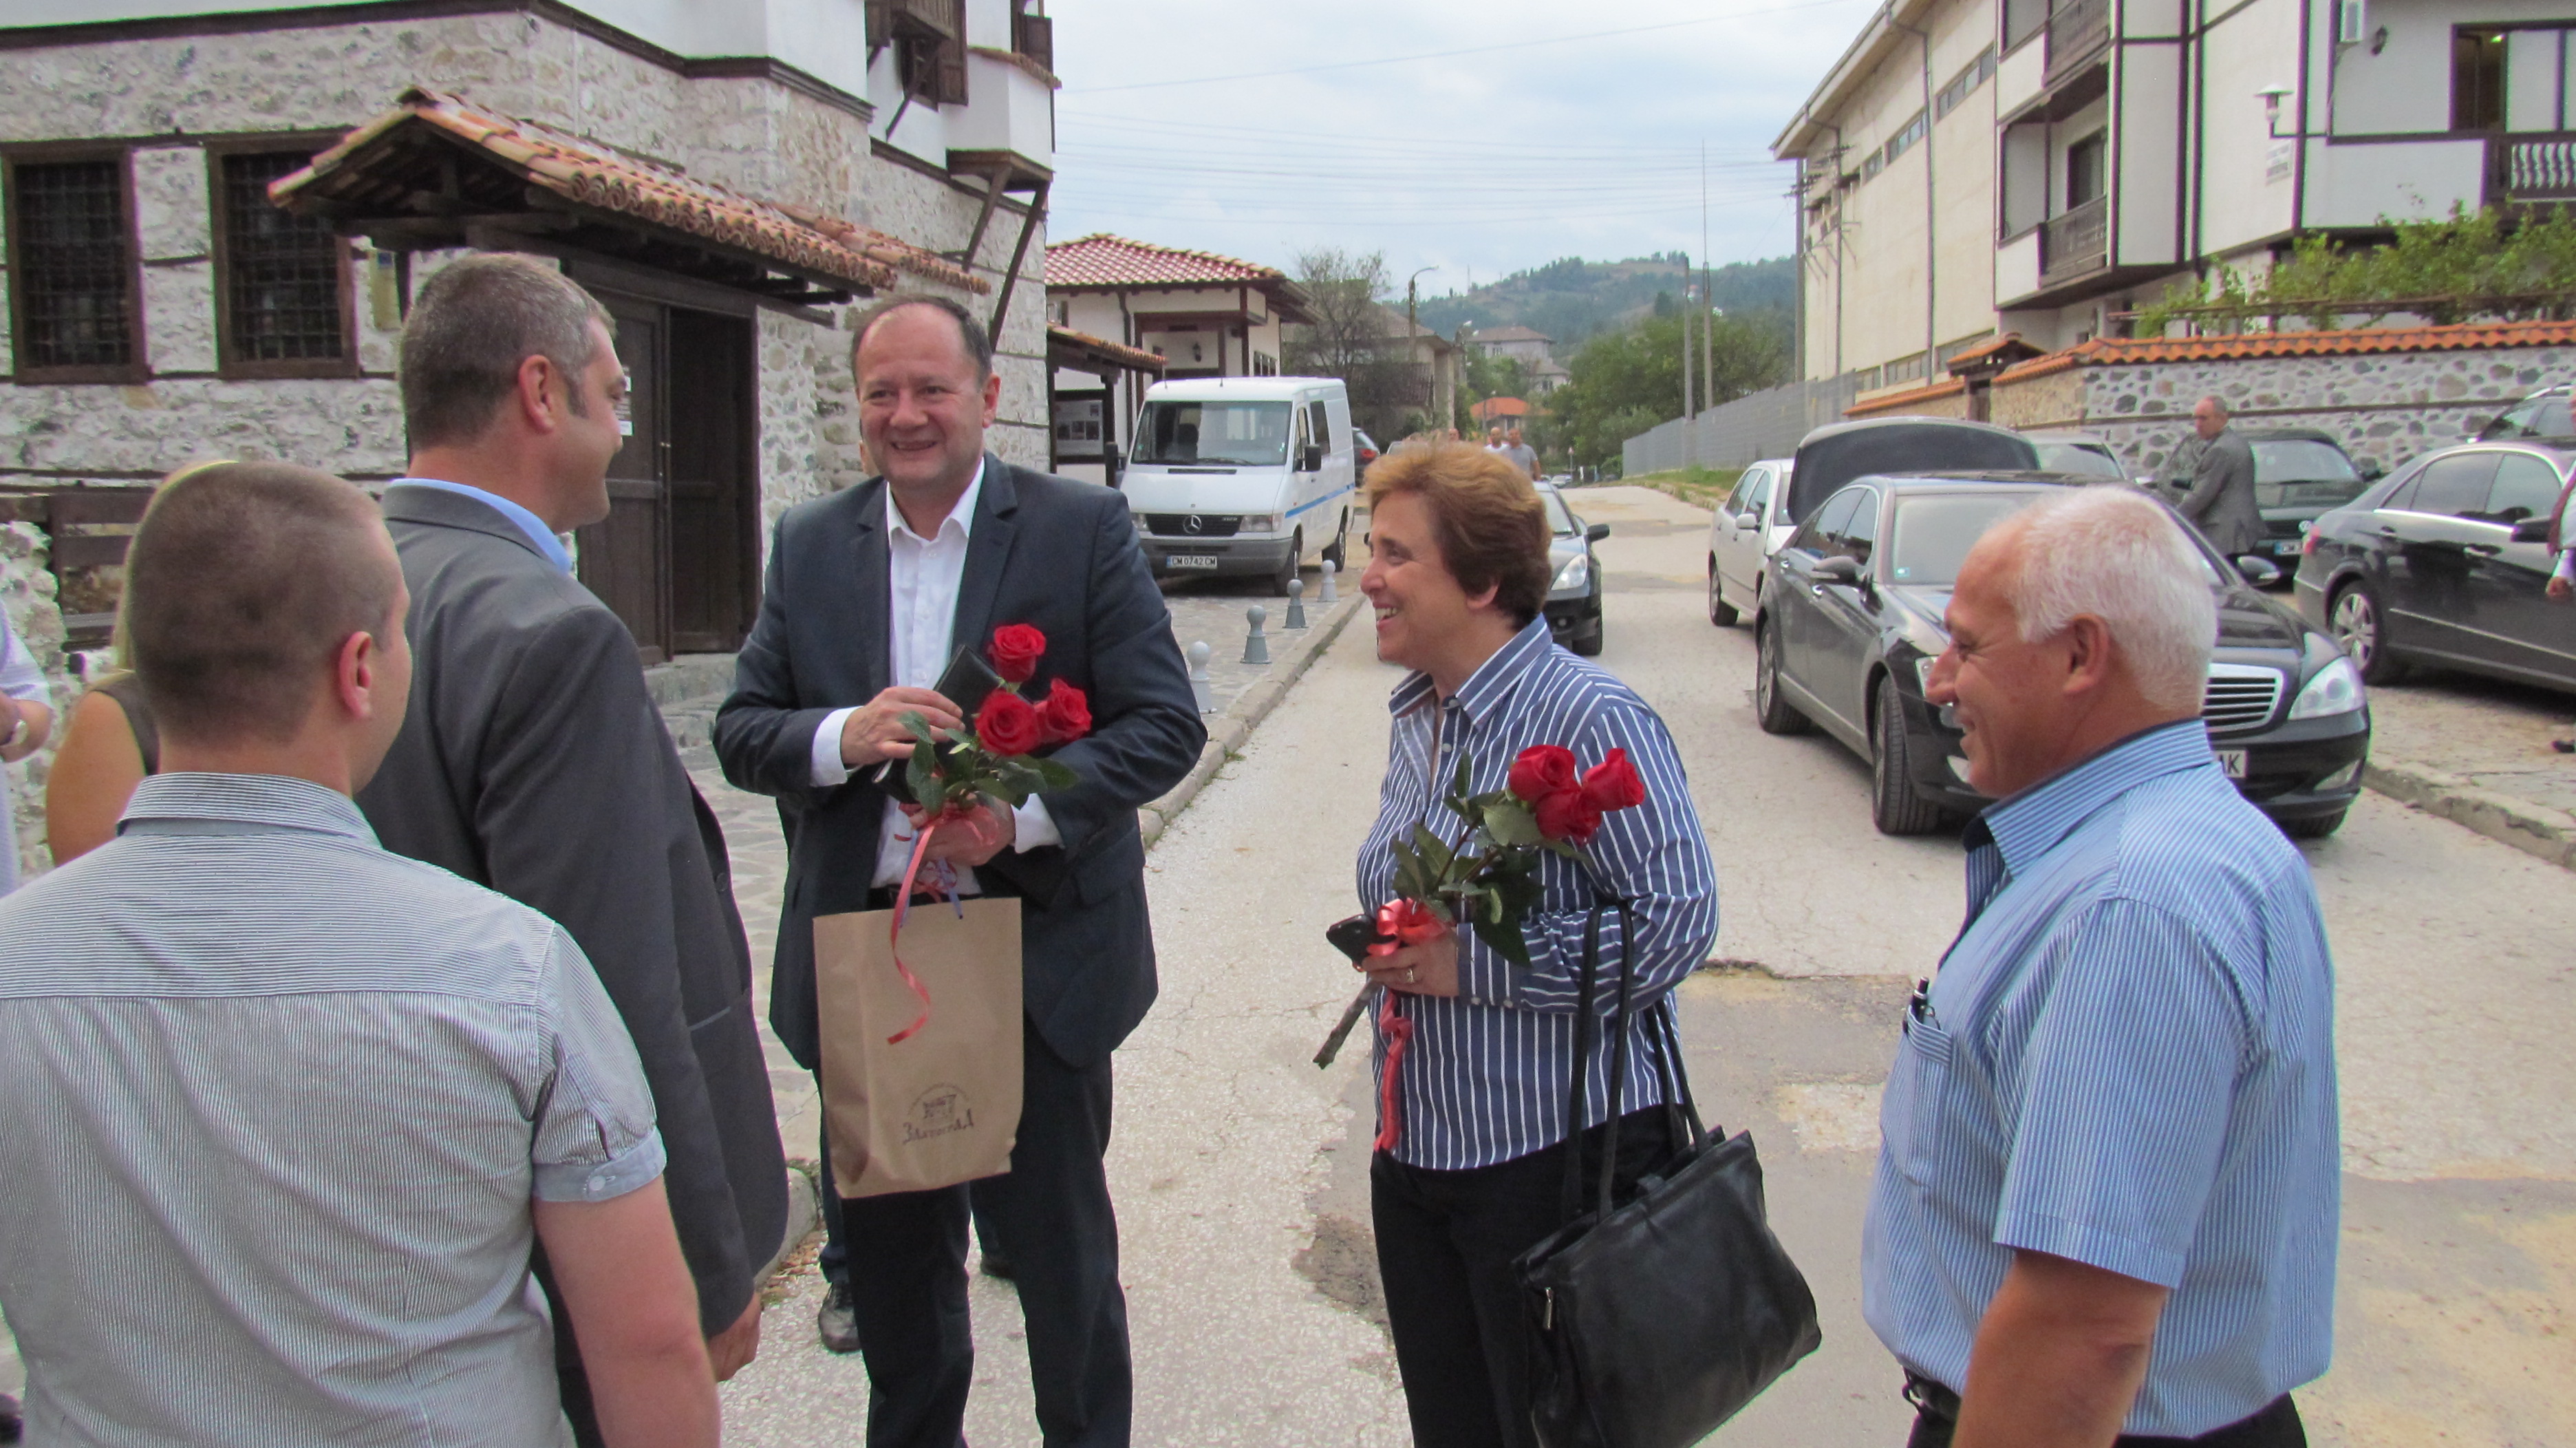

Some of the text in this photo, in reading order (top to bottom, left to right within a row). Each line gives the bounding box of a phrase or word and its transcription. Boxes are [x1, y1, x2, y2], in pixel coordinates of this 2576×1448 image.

[1172, 557, 1216, 566] CM 0742 CM
